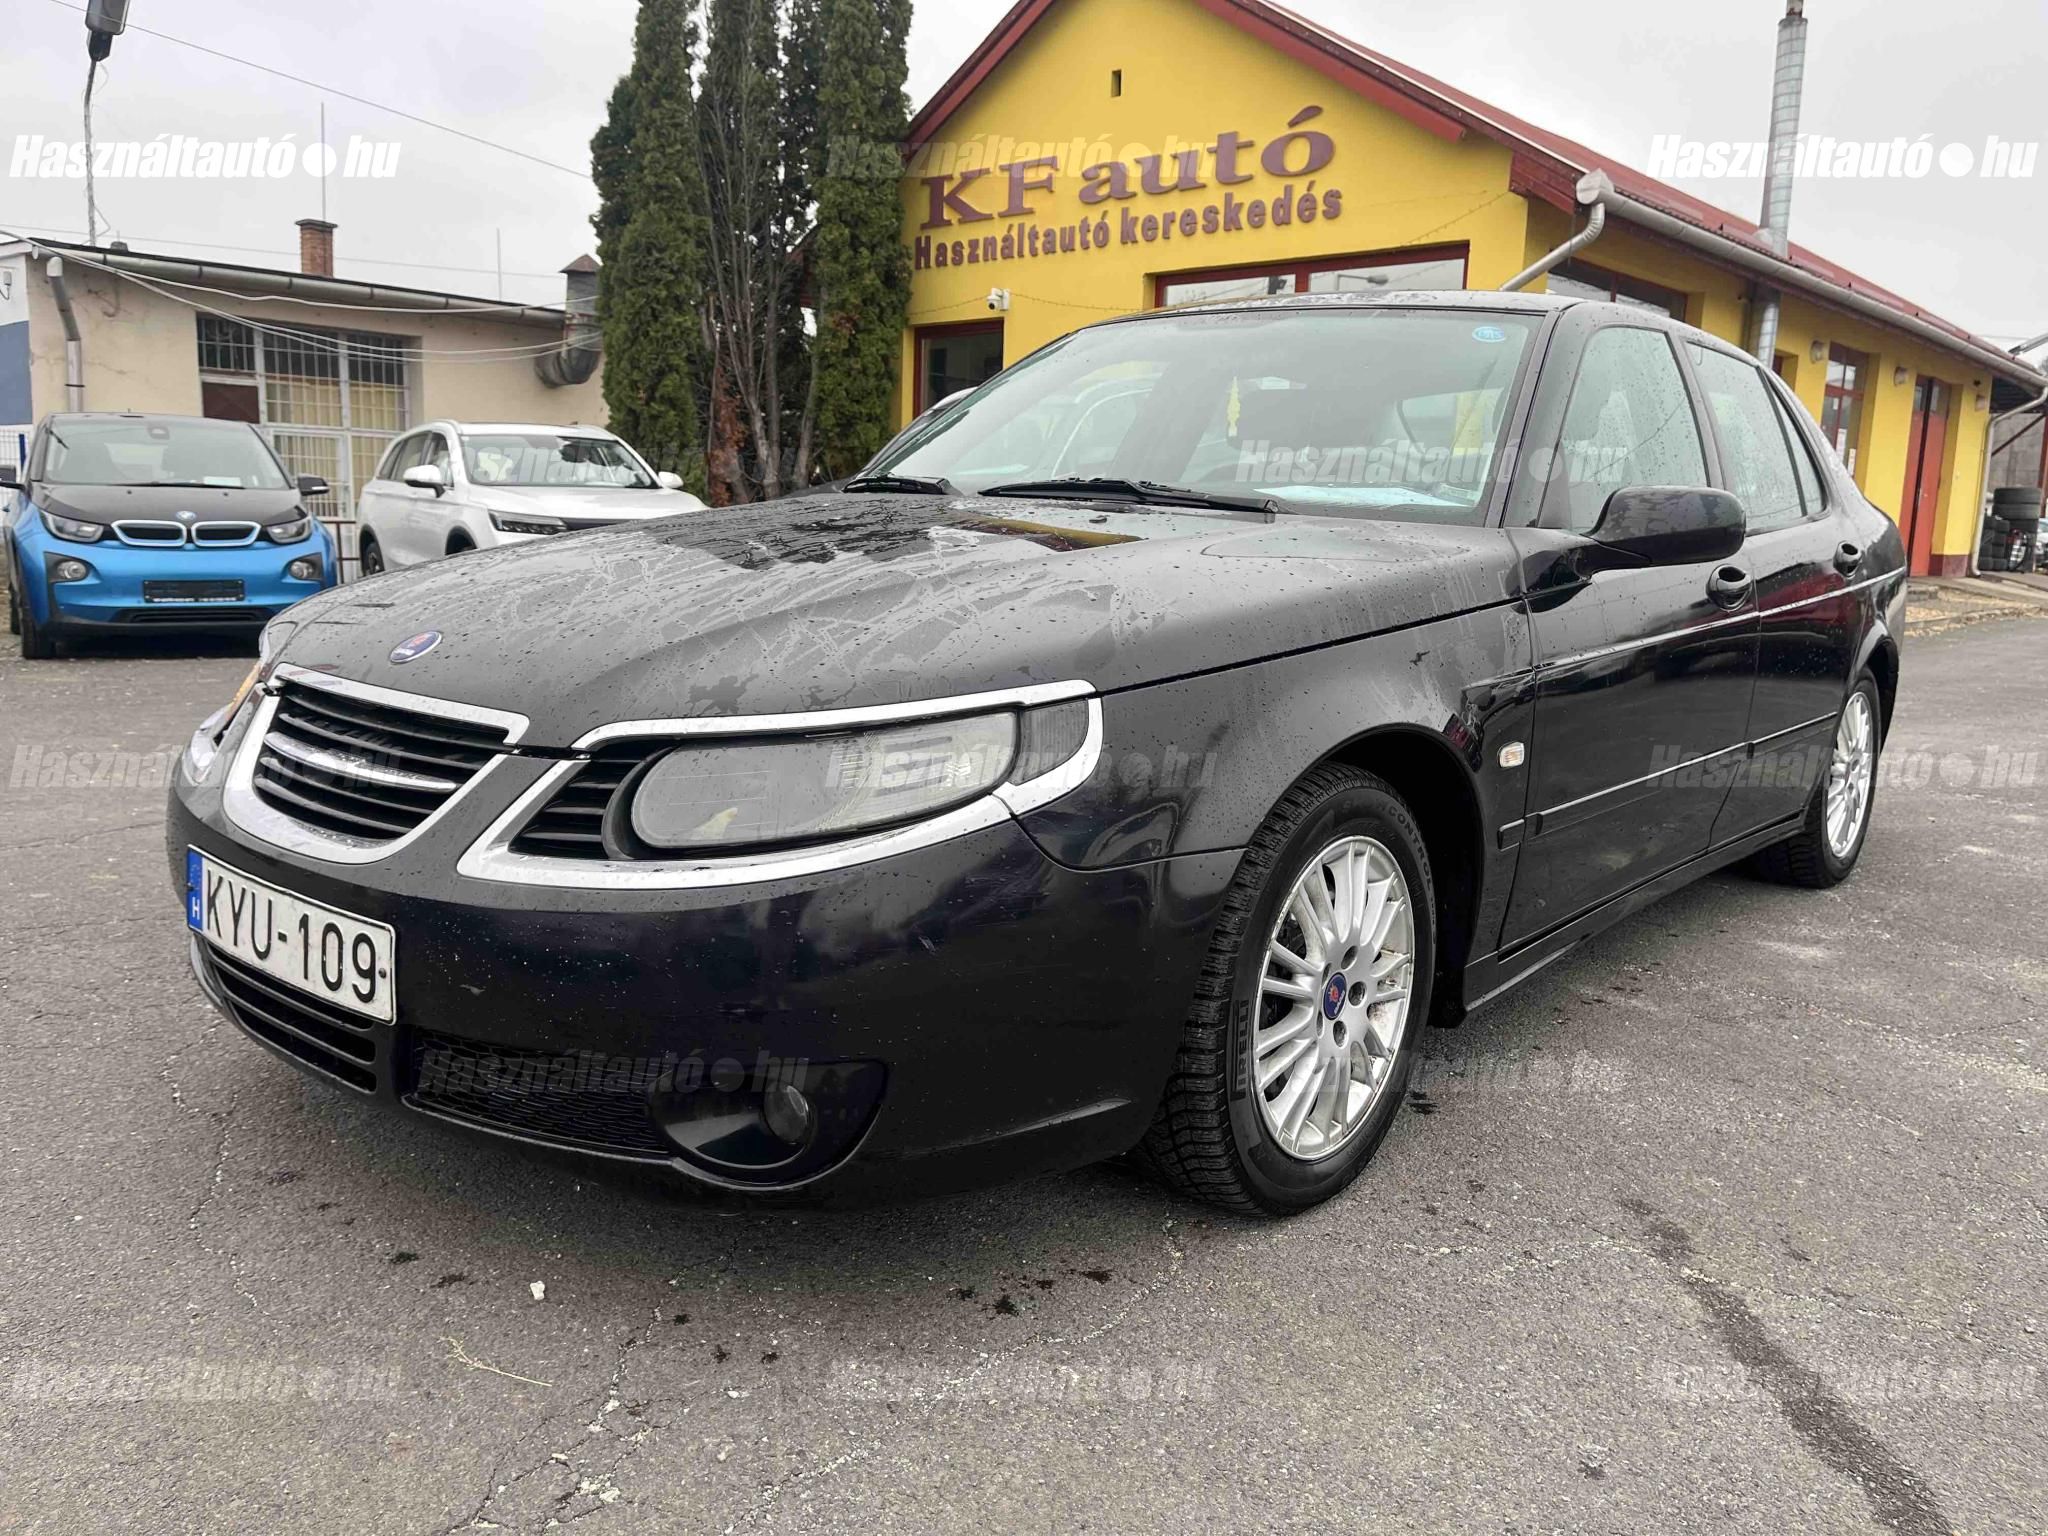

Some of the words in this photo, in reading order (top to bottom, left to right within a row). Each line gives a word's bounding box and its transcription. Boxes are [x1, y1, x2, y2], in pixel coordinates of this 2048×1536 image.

[1077, 104, 1337, 205] autó
[913, 210, 1111, 271] Használtautó
[1120, 180, 1344, 245] kereskedés
[207, 869, 377, 1004] KYU-109
